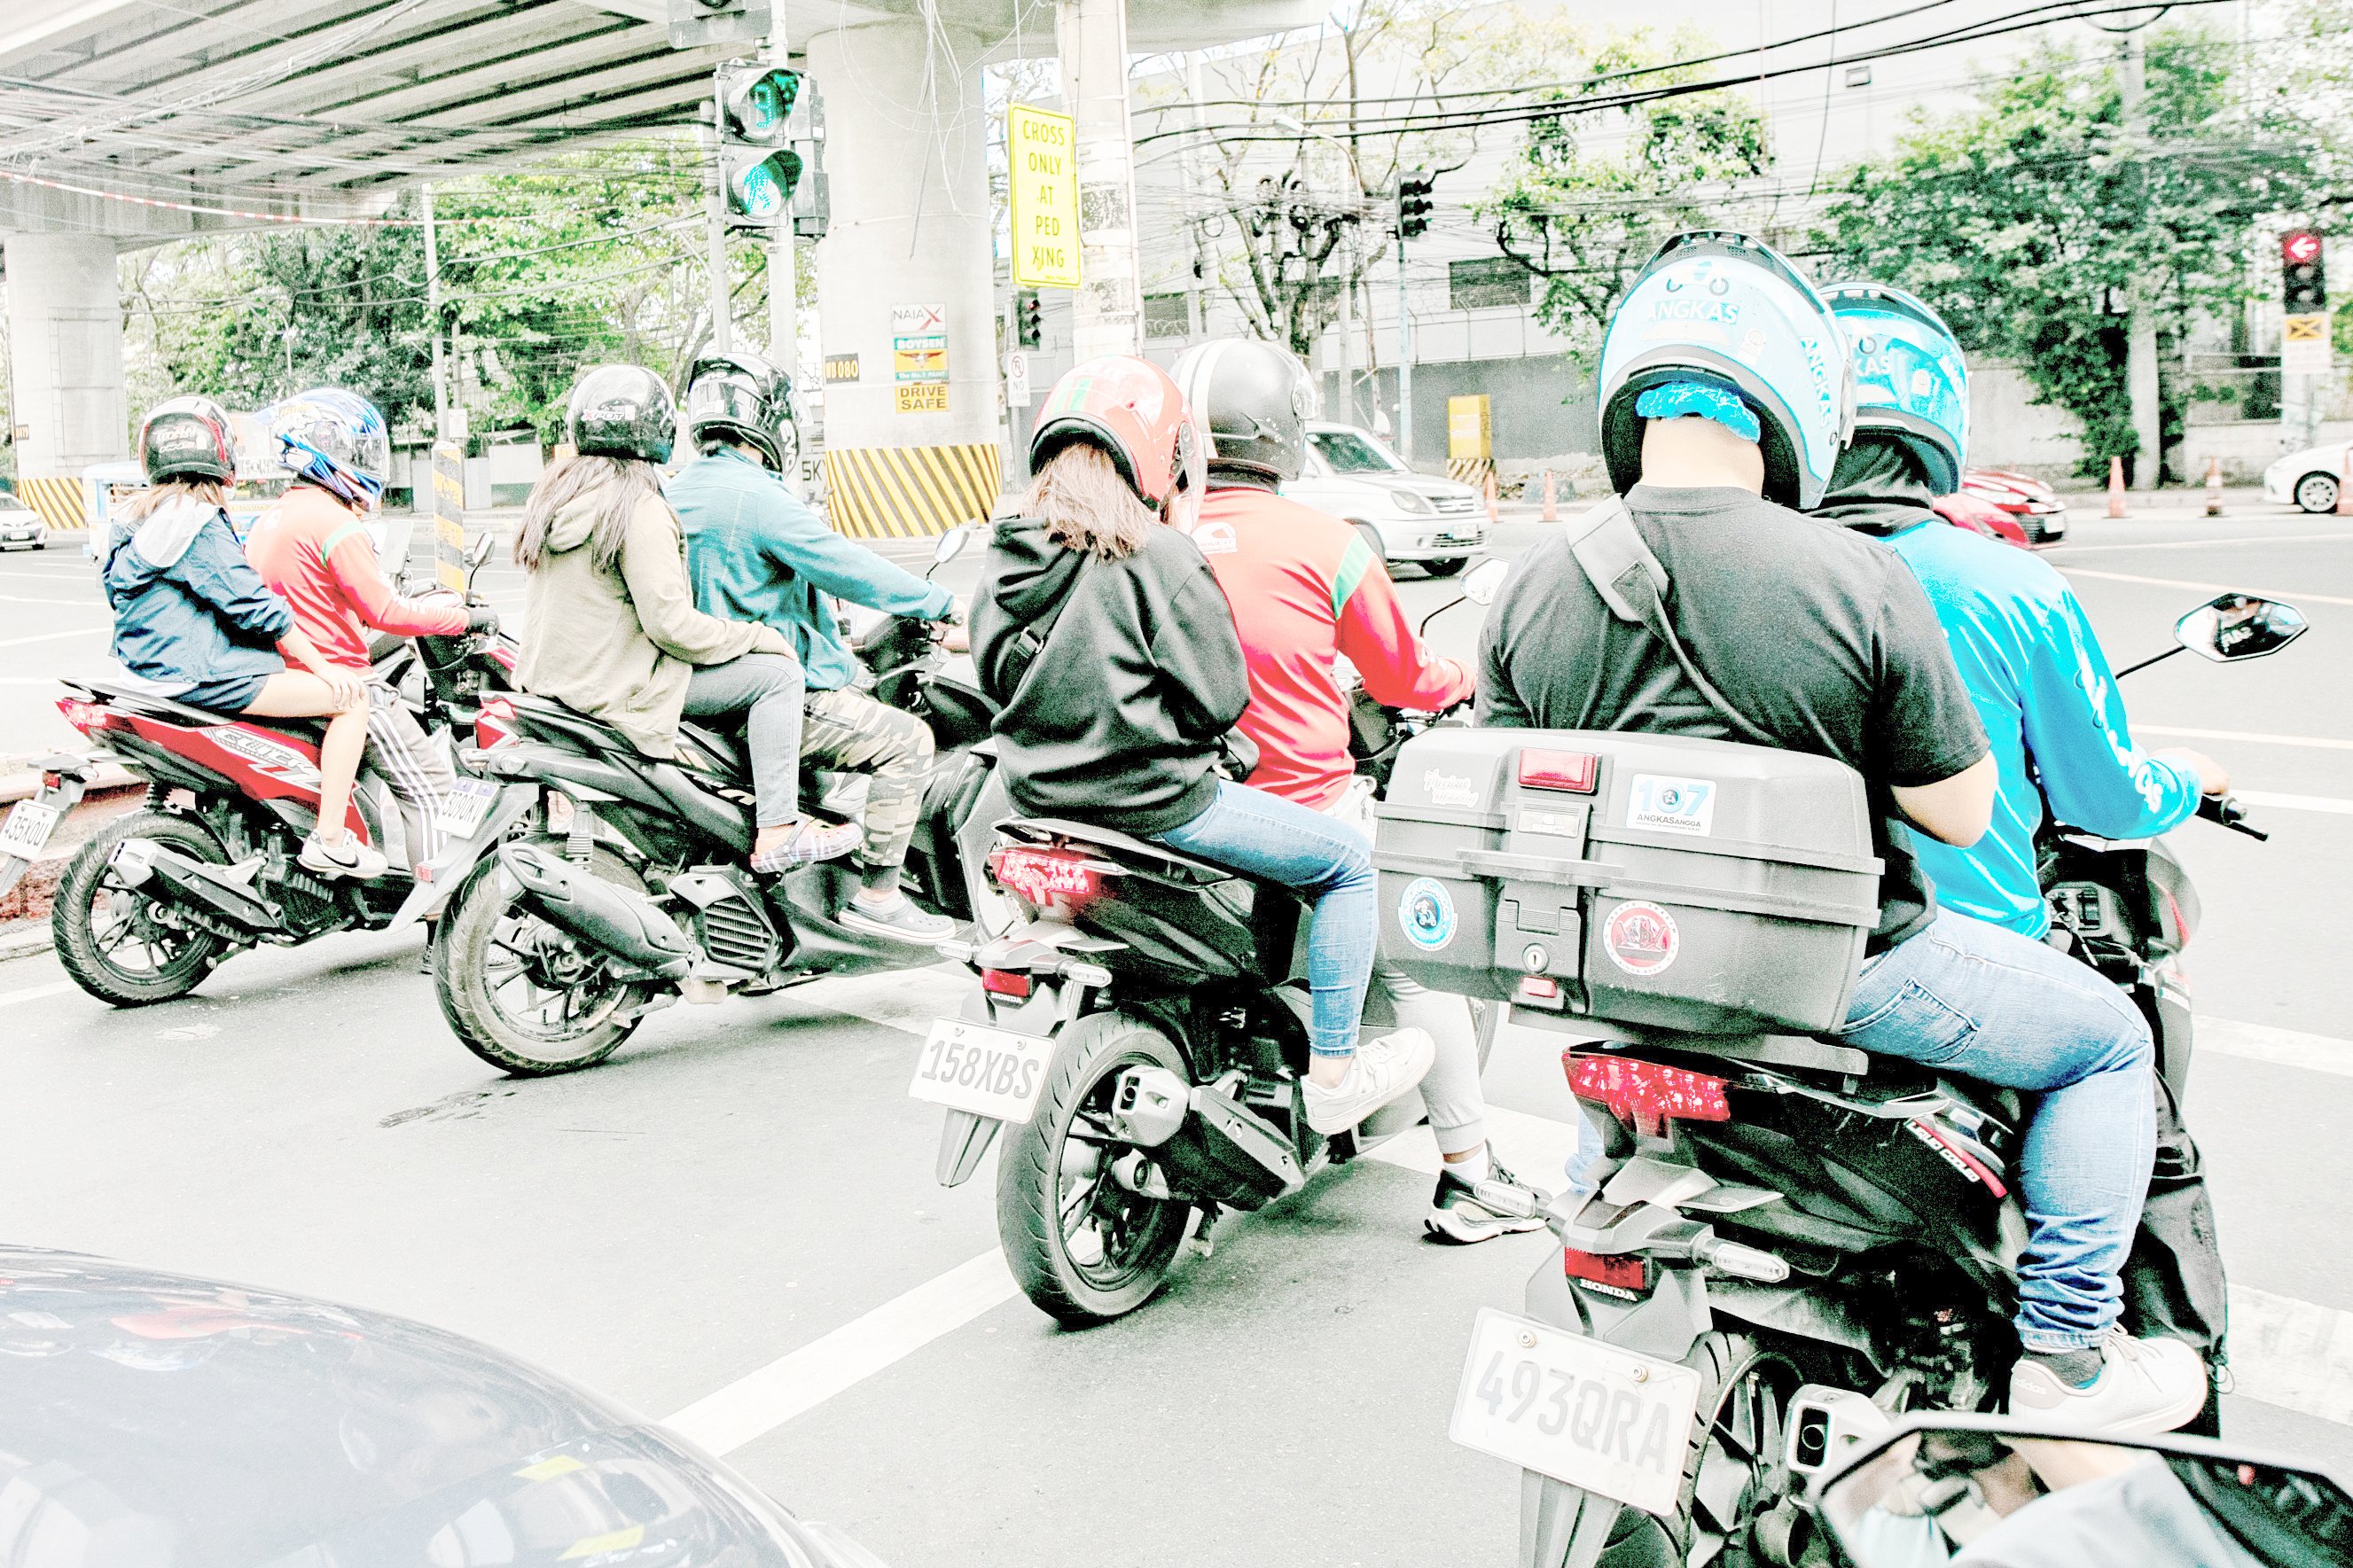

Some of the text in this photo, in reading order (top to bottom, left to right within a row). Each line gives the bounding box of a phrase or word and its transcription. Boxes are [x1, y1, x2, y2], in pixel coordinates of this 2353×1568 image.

[1022, 120, 1065, 146] CROSS
[1028, 152, 1061, 176] ONLY
[1039, 185, 1053, 206] AT
[1036, 215, 1060, 237] PED
[1032, 246, 1065, 268] XING
[1647, 300, 1739, 325] ANGKAS
[897, 338, 944, 349] BOYSEN
[900, 386, 946, 397] DRIVE
[1013, 381, 1024, 391] NO
[1800, 335, 1832, 428] ANGKAS
[901, 398, 946, 410] SAFE
[802, 459, 825, 481] SK
[989, 992, 1024, 1004] HONDA
[921, 1040, 1040, 1099] 158XBS
[1580, 1278, 1638, 1302] HONDA
[1475, 1350, 1670, 1475] 493QRA
